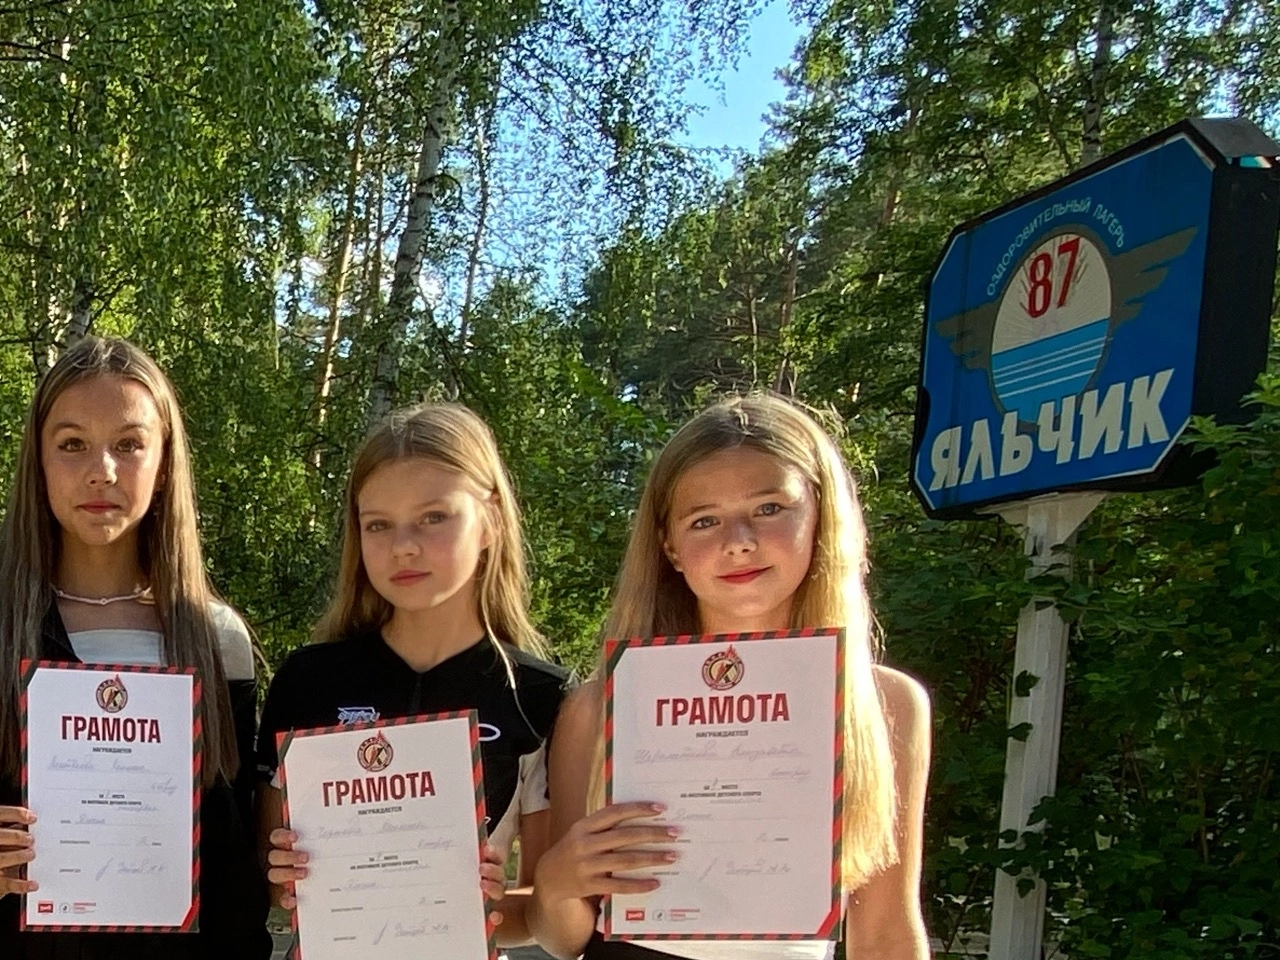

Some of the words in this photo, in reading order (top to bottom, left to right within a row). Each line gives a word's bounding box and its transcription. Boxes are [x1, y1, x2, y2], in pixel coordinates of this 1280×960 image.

[987, 197, 1092, 296] ОЗДОРОВИТЕЛЬНЫЙ
[1093, 204, 1125, 248] ЛАГЕРЬ
[1028, 236, 1081, 319] 87
[928, 368, 1175, 492] ЯЛЬЧИК
[61, 715, 161, 744] ГРАМОТА
[656, 693, 790, 727] ГРАМОТА
[322, 771, 436, 807] ГРАМОТА
